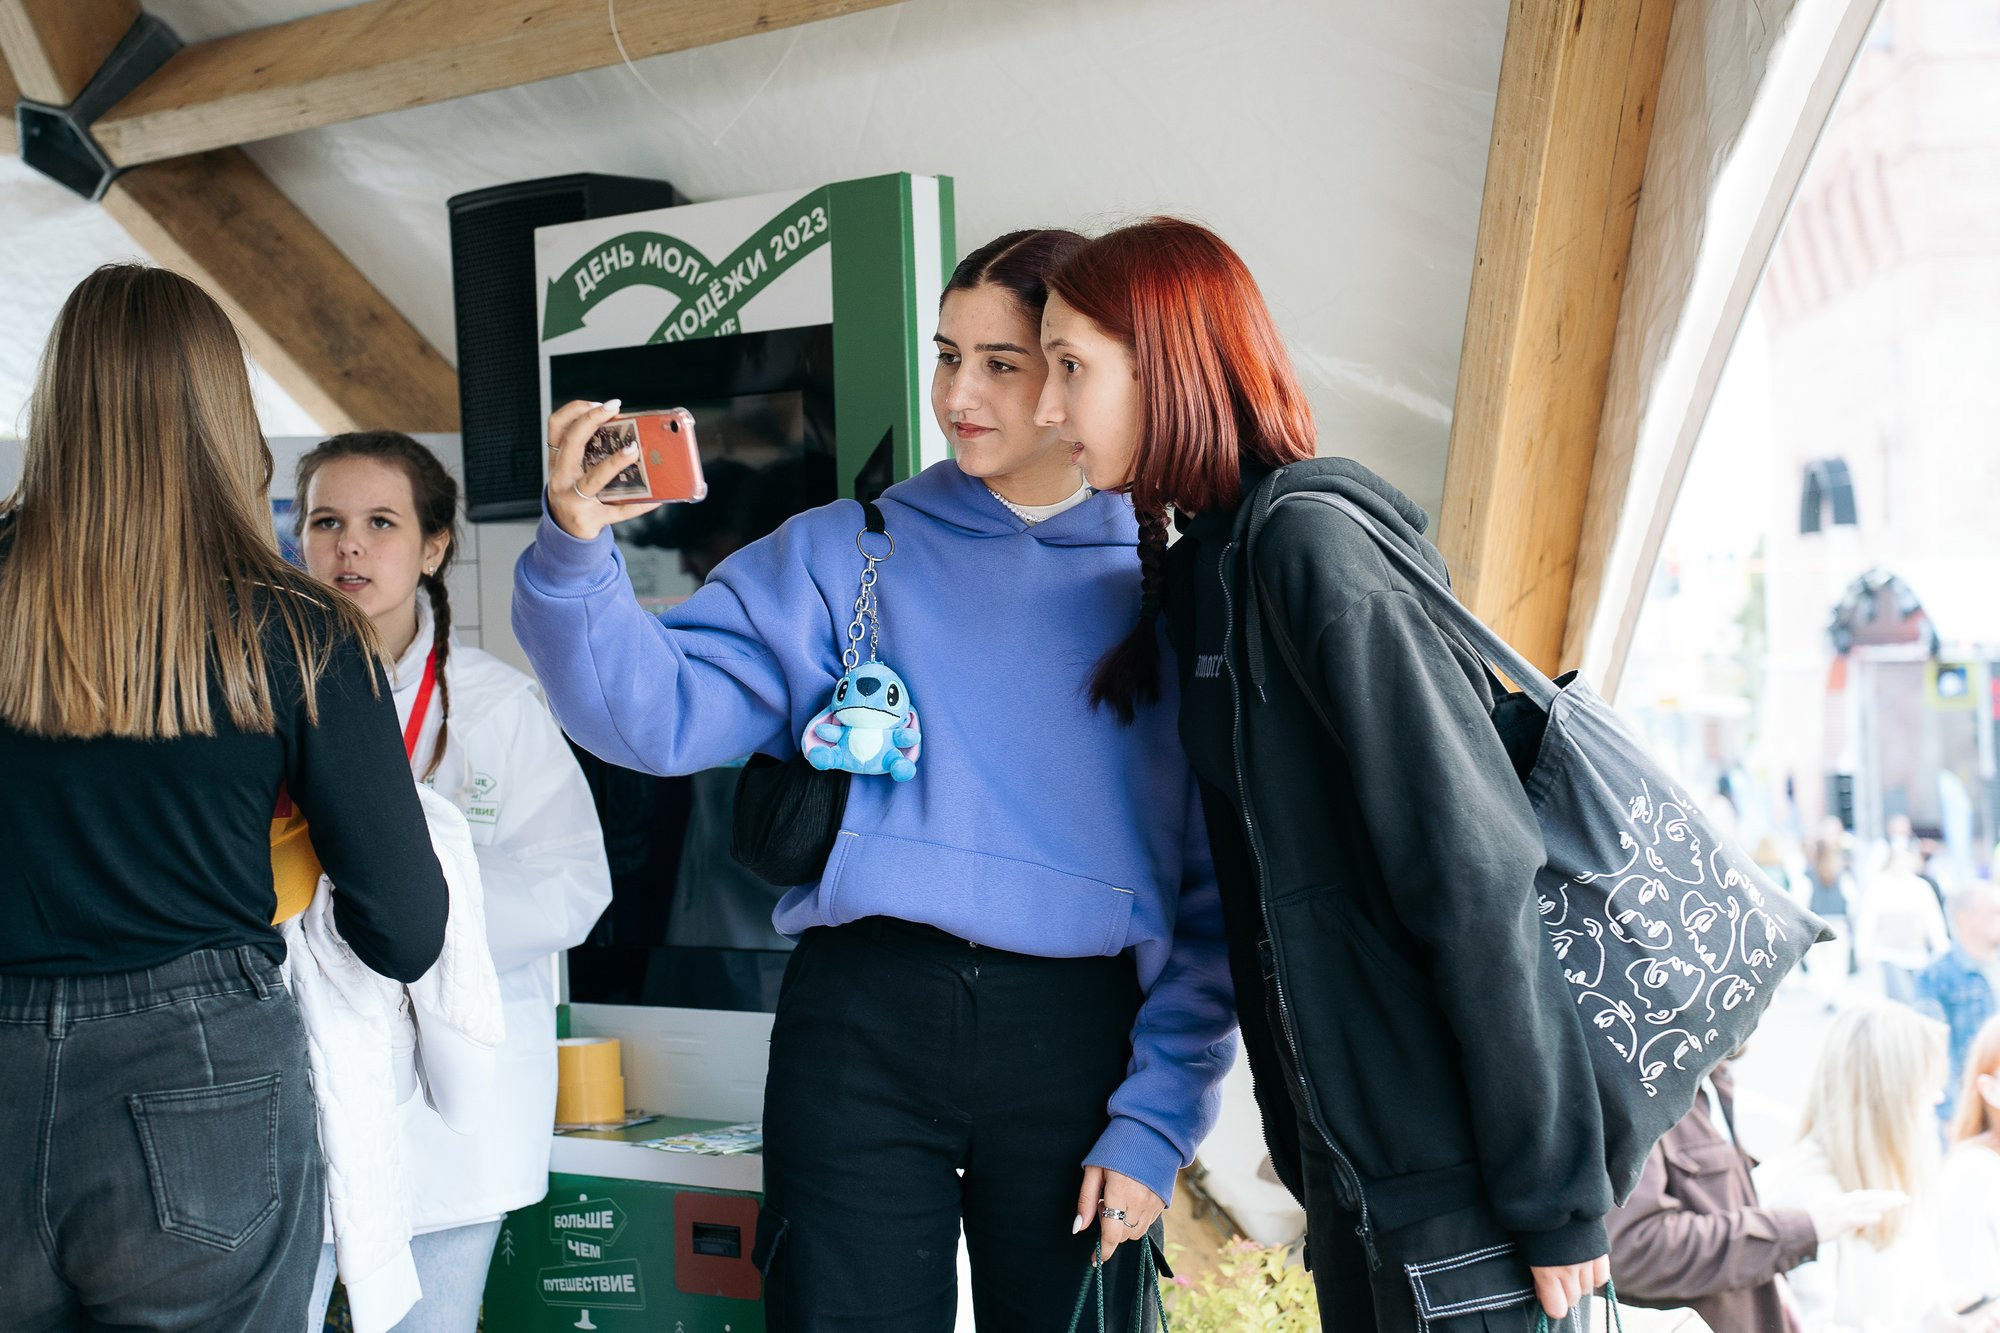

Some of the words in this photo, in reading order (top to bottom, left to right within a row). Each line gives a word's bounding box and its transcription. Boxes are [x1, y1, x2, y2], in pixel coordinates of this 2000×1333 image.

[769, 206, 829, 263] 2023
[574, 243, 635, 302] ДЕНЬ
[554, 1210, 614, 1229] БОЛЬШЕ
[567, 1239, 601, 1259] ЧЕМ
[543, 1274, 636, 1293] ПУТЕШЕСТВИЕ
